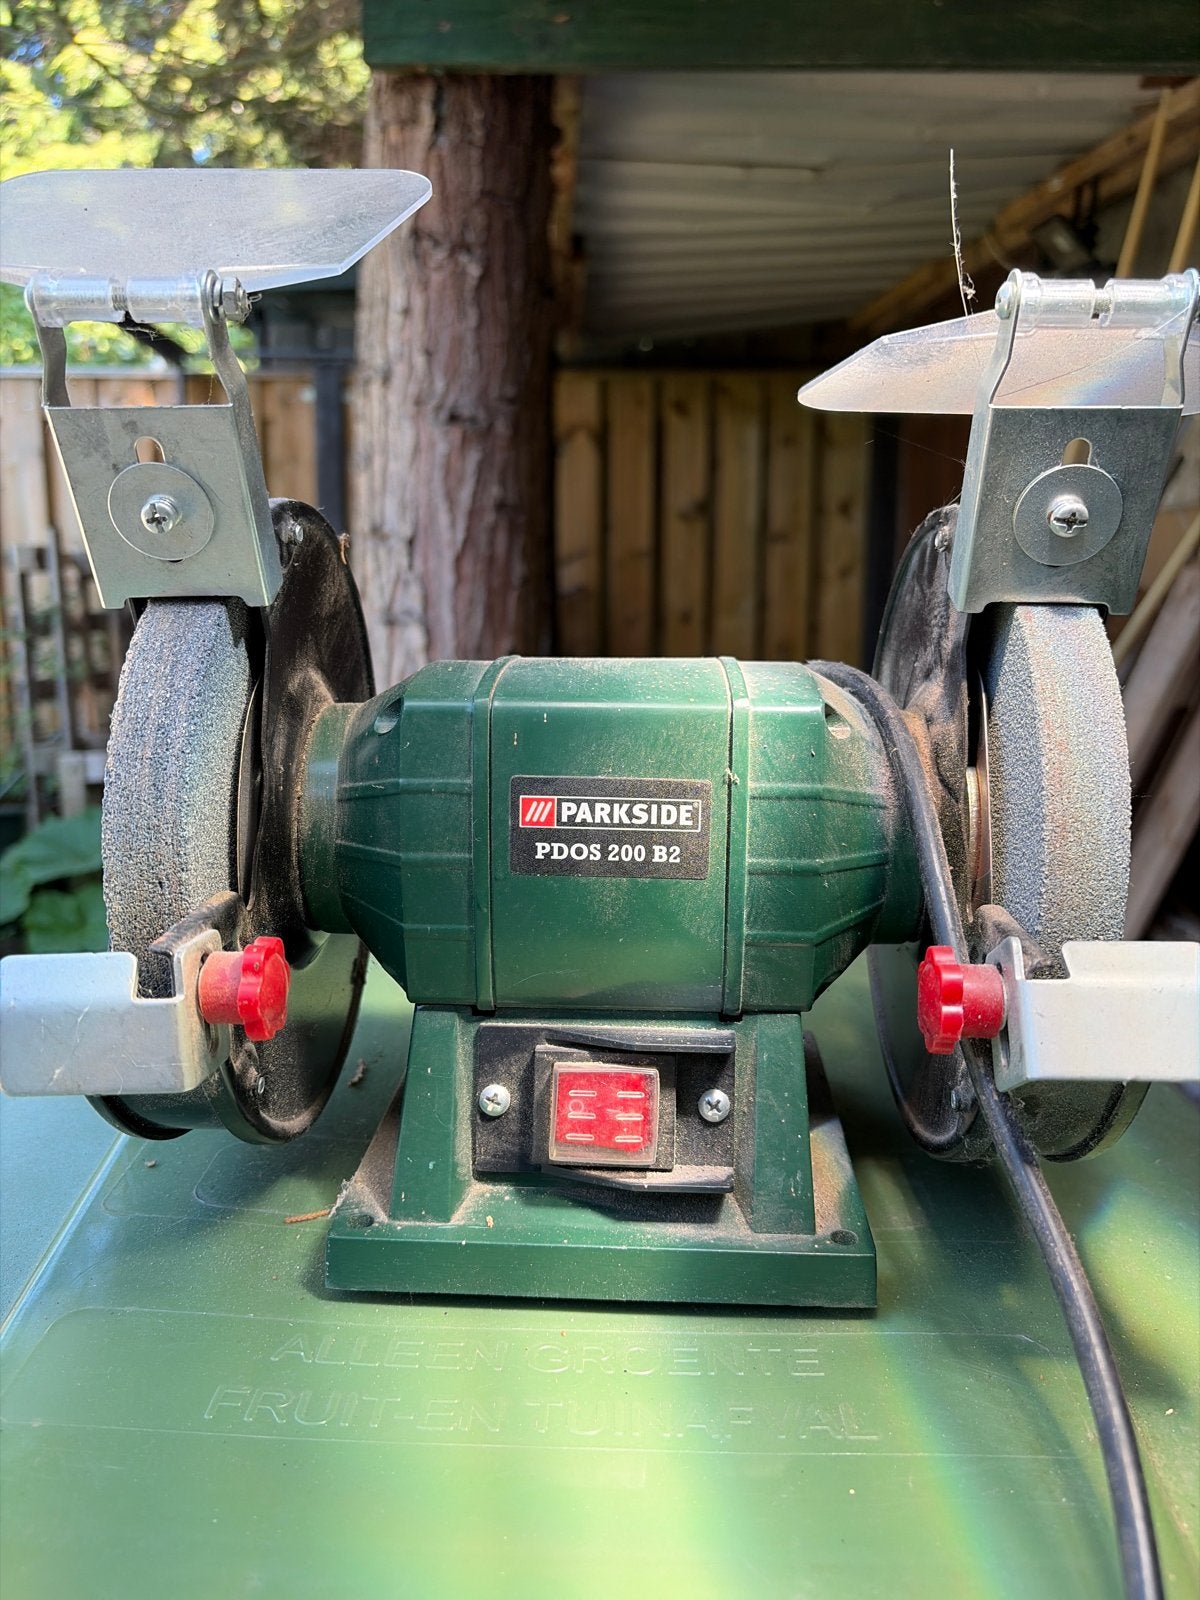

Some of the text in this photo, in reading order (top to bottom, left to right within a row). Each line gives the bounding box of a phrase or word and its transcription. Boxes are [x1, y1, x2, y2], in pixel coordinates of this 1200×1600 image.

[561, 801, 694, 826] PARKSIDE
[535, 842, 681, 863] PDOS 200 B2
[270, 1332, 826, 1376] ALLEEN GROENTE
